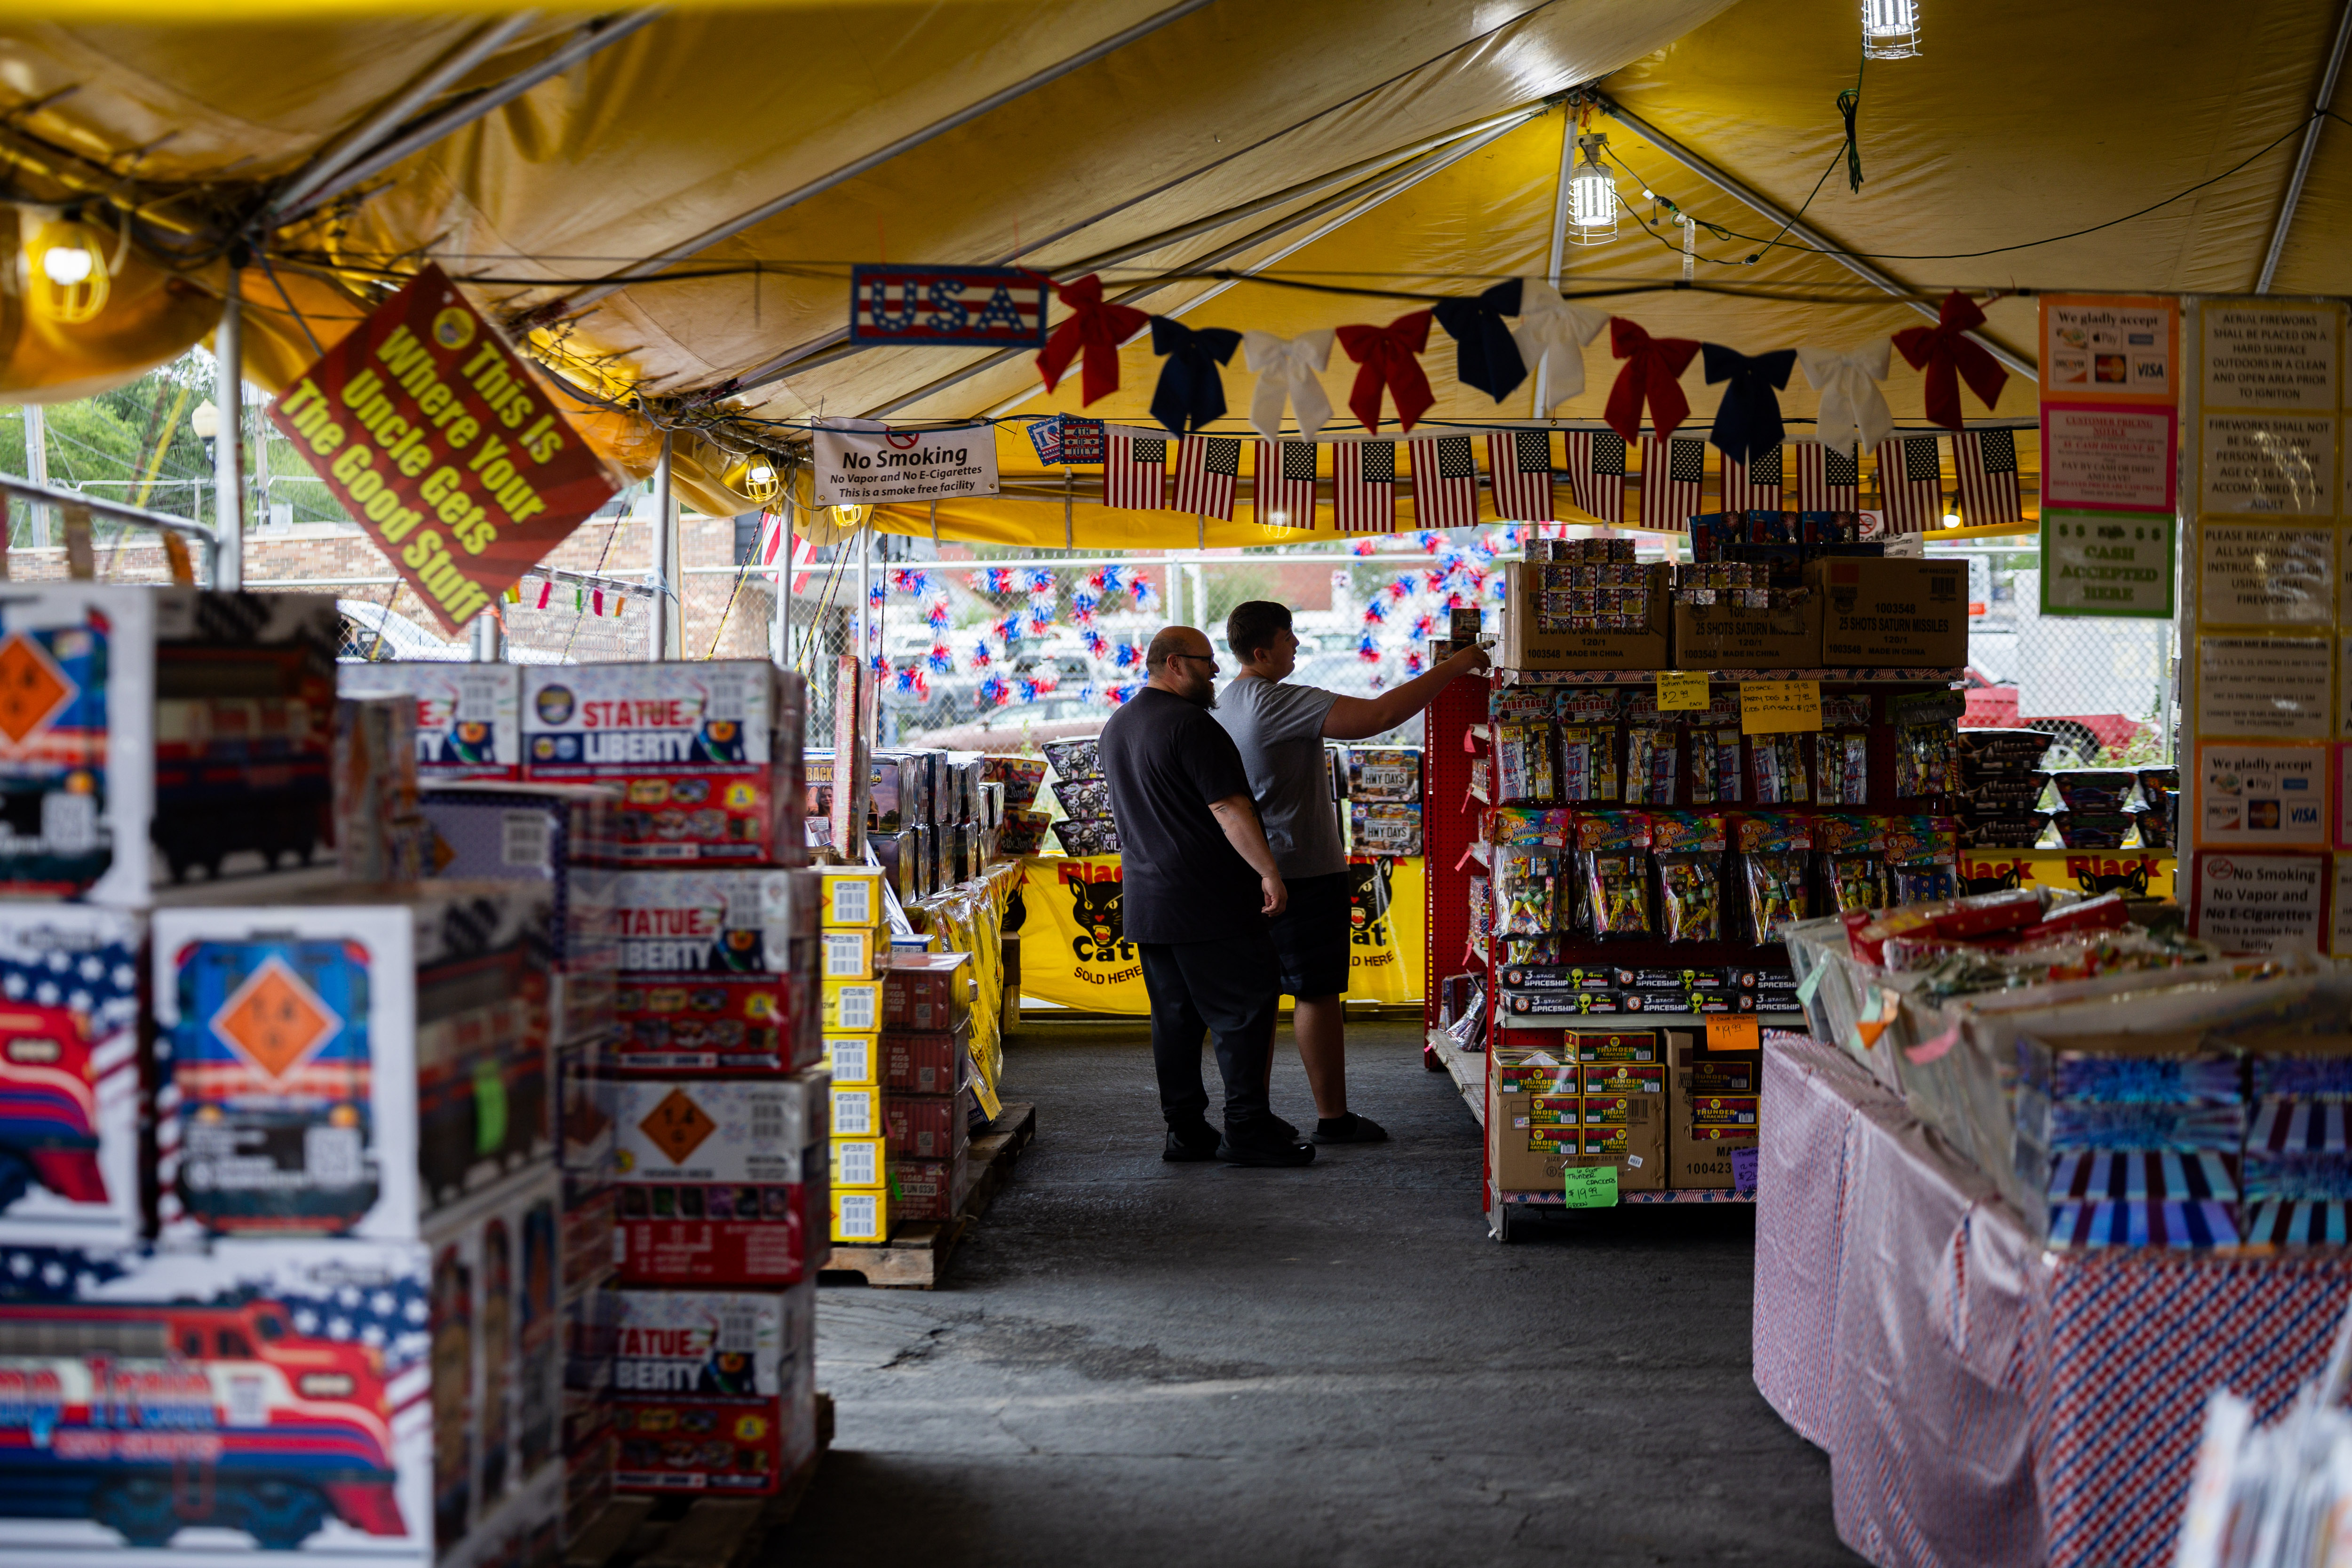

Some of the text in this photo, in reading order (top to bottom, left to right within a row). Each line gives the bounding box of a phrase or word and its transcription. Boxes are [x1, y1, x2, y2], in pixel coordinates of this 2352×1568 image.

[872, 279, 1025, 333] USA
[2059, 311, 2158, 327] We gladly accept
[2223, 314, 2317, 326] AERIAL FIREWORKS
[2214, 329, 2327, 341] SHALL BE PLACED ON A
[2233, 343, 2306, 355] HARD SURFACE
[2138, 363, 2164, 378] VISA
[2213, 358, 2327, 371] OUTDOORS IN A CLEAN
[2214, 373, 2327, 385] AND OPEN AREA PRIOR
[2239, 387, 2300, 399] TO IGNITION
[461, 341, 563, 464] This Is
[376, 324, 547, 524] Where Your
[2209, 420, 2329, 433] FIREWORKS SHALL NOT
[1036, 430, 1049, 447] I
[1073, 428, 1090, 438] 4TH
[2227, 436, 2311, 449] BE ANY
[842, 446, 967, 469] No Smoking
[1069, 447, 1094, 457] JULY
[2216, 452, 2257, 463] PERSON
[341, 368, 497, 556] Uncle Gets
[830, 466, 982, 485] No Vapor and No E-Cigarettes
[2220, 468, 2274, 478] AGE 16
[839, 488, 860, 497] This
[863, 488, 870, 497] is
[882, 486, 915, 496] smoke
[918, 484, 938, 493] free
[938, 480, 976, 492] facility
[280, 378, 345, 456] The
[332, 444, 423, 545] Good
[403, 530, 490, 624] Stuff
[2251, 498, 2284, 509] ADULT
[2206, 531, 2300, 542] PLEASE AND
[2084, 545, 2135, 561] CASH
[2215, 546, 2234, 557] ALL
[2059, 565, 2159, 582] ACCEPTED
[2084, 586, 2134, 601] HERE
[1875, 603, 1916, 614] 1003548
[1696, 622, 1767, 635] 25 SHOTS SATURN
[1839, 617, 1948, 632] 25 SHOTS SATURN MISSILES
[1527, 649, 1560, 659] 1003548
[1685, 649, 1717, 659] 1003548
[1502, 699, 1547, 709] KIDS SACK
[1566, 702, 1587, 711] KIDS
[583, 701, 681, 727] STATUE
[583, 731, 694, 763] LIBERTY
[2212, 758, 2312, 772] We gladly accept
[806, 767, 833, 782] BACK
[1366, 773, 1404, 784] HWY DAYS
[2256, 778, 2272, 790] Pay
[2291, 808, 2317, 823] VISA
[1368, 827, 1406, 837] HWY DAYS
[1513, 824, 1562, 837] KID'S FUN
[1600, 829, 1627, 841] KID'S
[2066, 853, 2162, 878] Black
[2233, 868, 2316, 884] No Smoking
[2213, 889, 2308, 904] No Vapor and
[2206, 908, 2312, 923] No E-Cigarettes
[2212, 925, 2231, 936] This
[2233, 925, 2241, 935] is
[2251, 926, 2282, 936] smoke
[2284, 926, 2304, 936] free
[1073, 935, 1135, 962] Cat
[2241, 939, 2273, 951] facility
[1364, 950, 1394, 966] HERE
[1074, 965, 1143, 984] SOLD HERE
